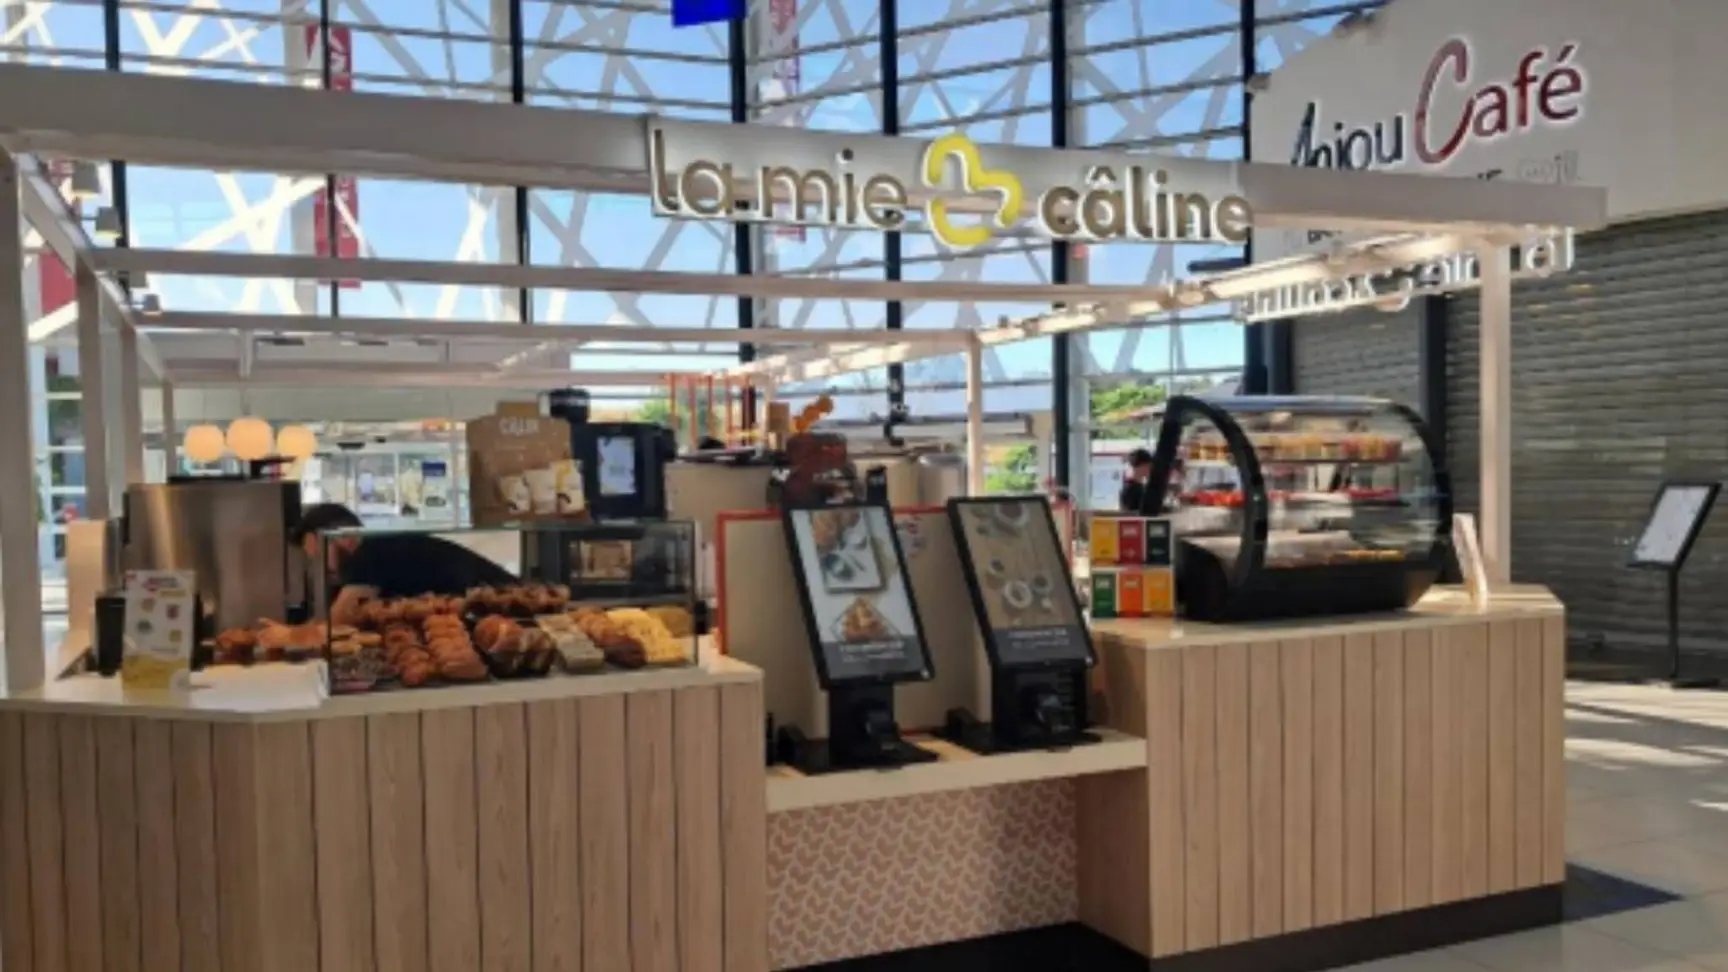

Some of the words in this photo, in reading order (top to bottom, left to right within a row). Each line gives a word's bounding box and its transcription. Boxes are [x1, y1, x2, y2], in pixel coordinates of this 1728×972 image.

[1414, 37, 1585, 165] Café
[650, 127, 735, 220] la
[759, 147, 908, 230] mie
[1038, 164, 1254, 245] câline
